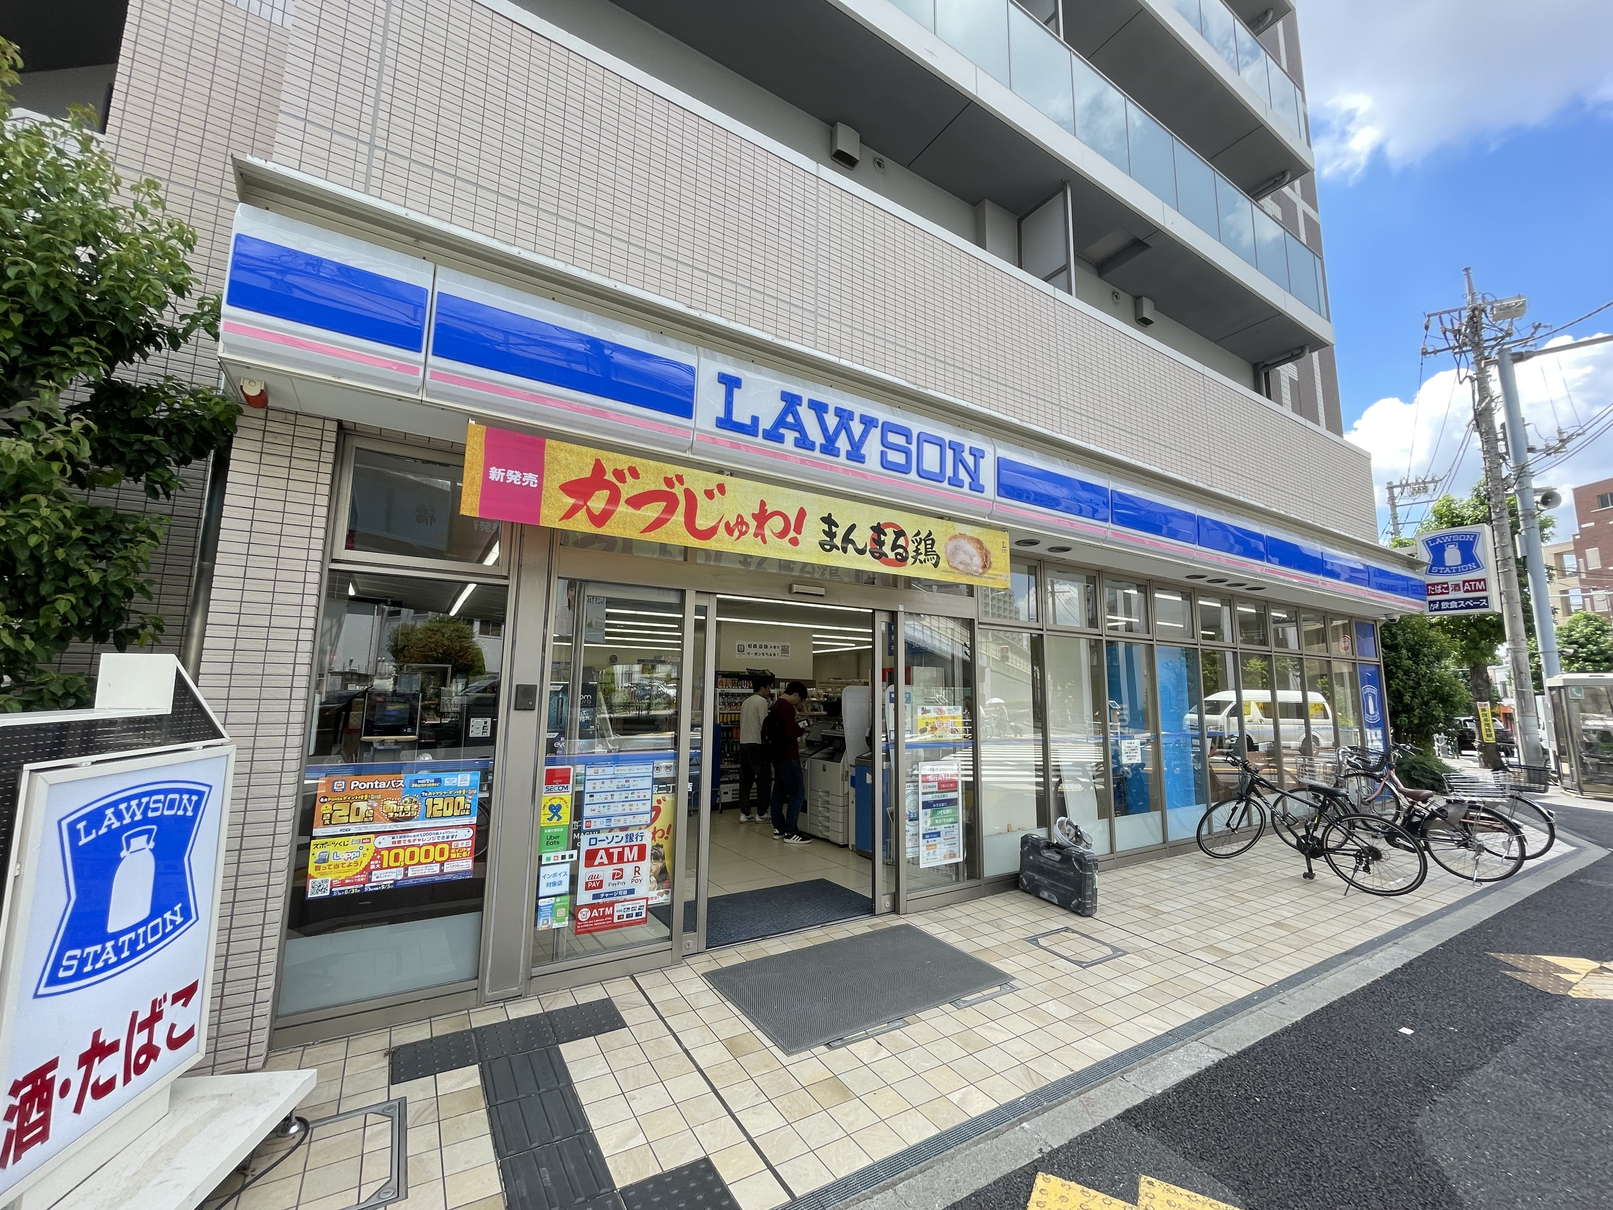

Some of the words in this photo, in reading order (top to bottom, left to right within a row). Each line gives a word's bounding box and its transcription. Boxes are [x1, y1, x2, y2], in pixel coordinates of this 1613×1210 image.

[716, 372, 985, 493] LAWSON
[488, 466, 538, 488] 新発売
[819, 512, 941, 569] まんまる鶏
[1428, 534, 1475, 547] LAWSON
[1431, 562, 1477, 574] STATION
[1428, 583, 1449, 594] たばこ
[1464, 581, 1486, 591] ATM
[1441, 599, 1488, 609] 飲食スペース
[351, 779, 404, 791] Pontaパス
[331, 801, 368, 825] 20
[426, 796, 465, 819] 1200
[76, 793, 199, 847] LAWSON
[588, 832, 644, 846] ローソン銀行
[593, 846, 639, 866] ATM
[587, 873, 600, 881] au
[591, 906, 613, 918] ATM
[58, 902, 184, 978] STATION
